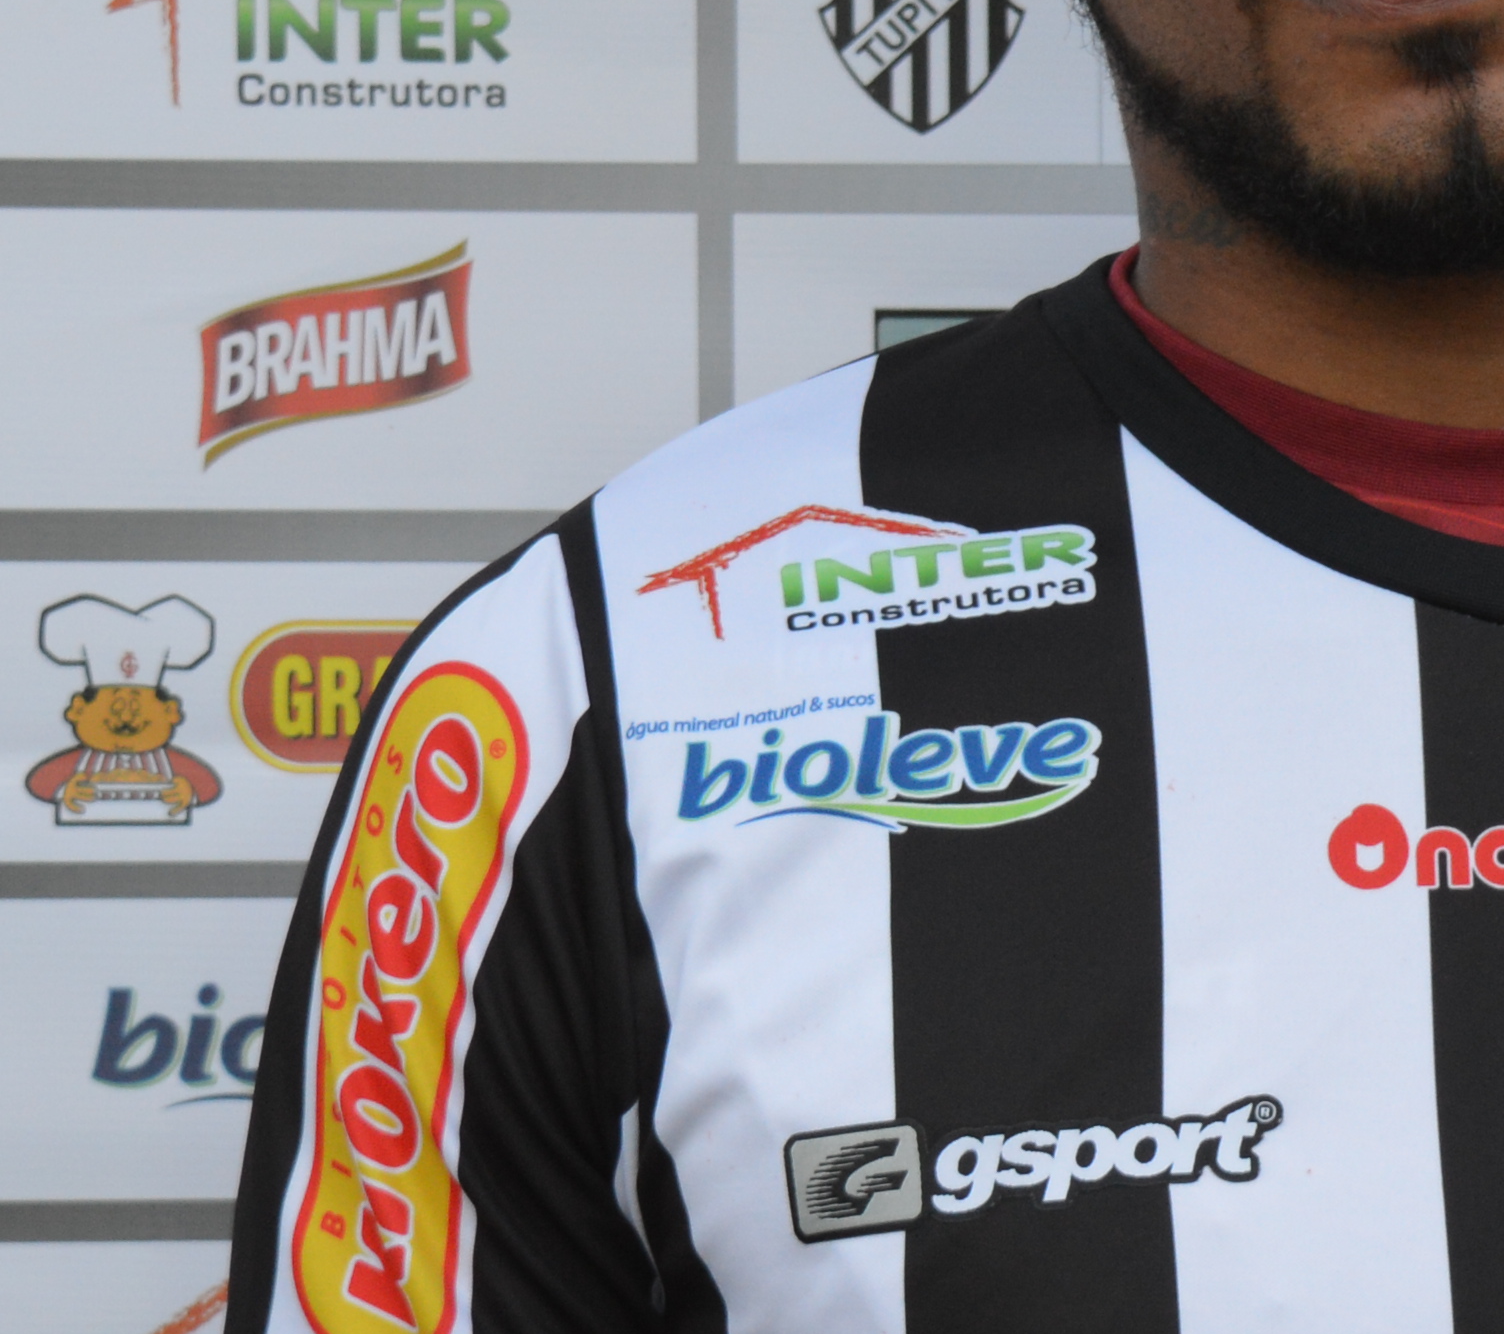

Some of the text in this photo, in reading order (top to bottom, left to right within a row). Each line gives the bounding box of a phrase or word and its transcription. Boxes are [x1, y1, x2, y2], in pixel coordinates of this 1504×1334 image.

[237, 73, 506, 108] Construtora
[214, 289, 457, 415] BRAHMA
[781, 531, 1086, 607] INTER
[787, 577, 1086, 632] Construtora
[674, 713, 739, 733] mineral
[744, 700, 805, 726] natural
[809, 695, 823, 712] &
[827, 692, 876, 709] sucos
[677, 716, 1090, 820] bioleve
[934, 1106, 1256, 1212] gsport
